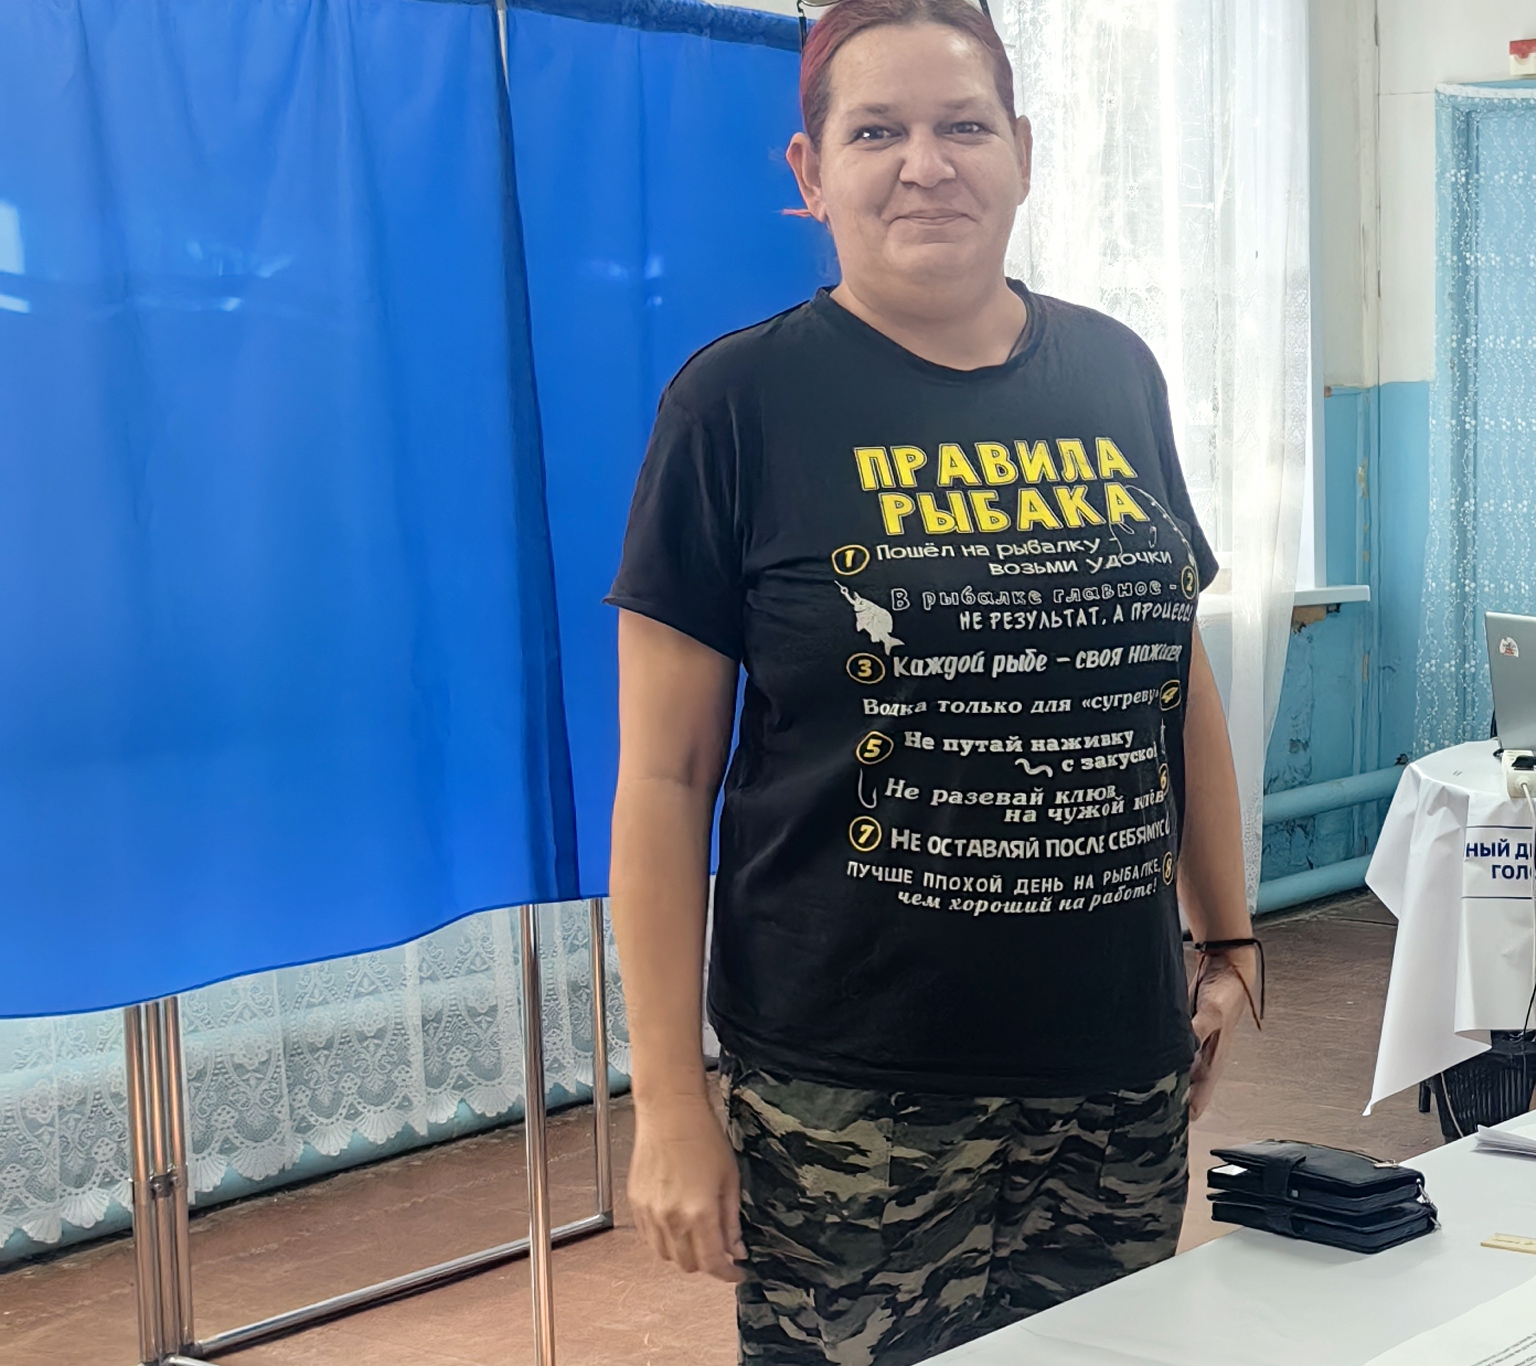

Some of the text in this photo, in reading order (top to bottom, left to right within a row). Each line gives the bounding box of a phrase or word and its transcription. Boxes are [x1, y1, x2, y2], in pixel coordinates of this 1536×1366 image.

[853, 437, 1138, 491] ПРАВИЛА
[878, 481, 1150, 535] РЫБАКА
[876, 540, 955, 561] Пошёл
[961, 543, 990, 558] на
[996, 537, 1101, 560] рыбалку
[988, 549, 1173, 577] возьми удочки
[890, 587, 911, 611] В
[922, 586, 1043, 611] рыбалке
[1053, 580, 1162, 604] главное
[959, 602, 1194, 632] НЕ РЕЗУЛЬТАТ, А ПРОЦЕСС!
[893, 650, 985, 680] Каждой
[992, 648, 1048, 678] рыбе
[1075, 646, 1124, 670] своя
[862, 697, 928, 717] Водка
[937, 698, 1023, 714] только
[1030, 699, 1072, 714] для
[903, 730, 936, 750] Не
[942, 734, 1023, 757] путай
[1031, 729, 1134, 754] наживку
[1061, 758, 1075, 773] с
[884, 777, 1117, 807] Не разевай клюв
[1003, 807, 1037, 823] на
[1048, 794, 1126, 825] чужой
[890, 828, 922, 852] НЕ
[927, 834, 1040, 860] ОСТАВЛЯЙ
[1045, 835, 1106, 858] ПОСЛЕ
[1109, 825, 1147, 851] СЕБЯ
[846, 861, 913, 884] ЛУЧШЕ
[922, 871, 1003, 894] ПЛОХОЙ
[1013, 878, 1064, 895] ДЕНЬ
[1073, 874, 1095, 890] НА
[897, 879, 1159, 916] чем хороший на работе!
